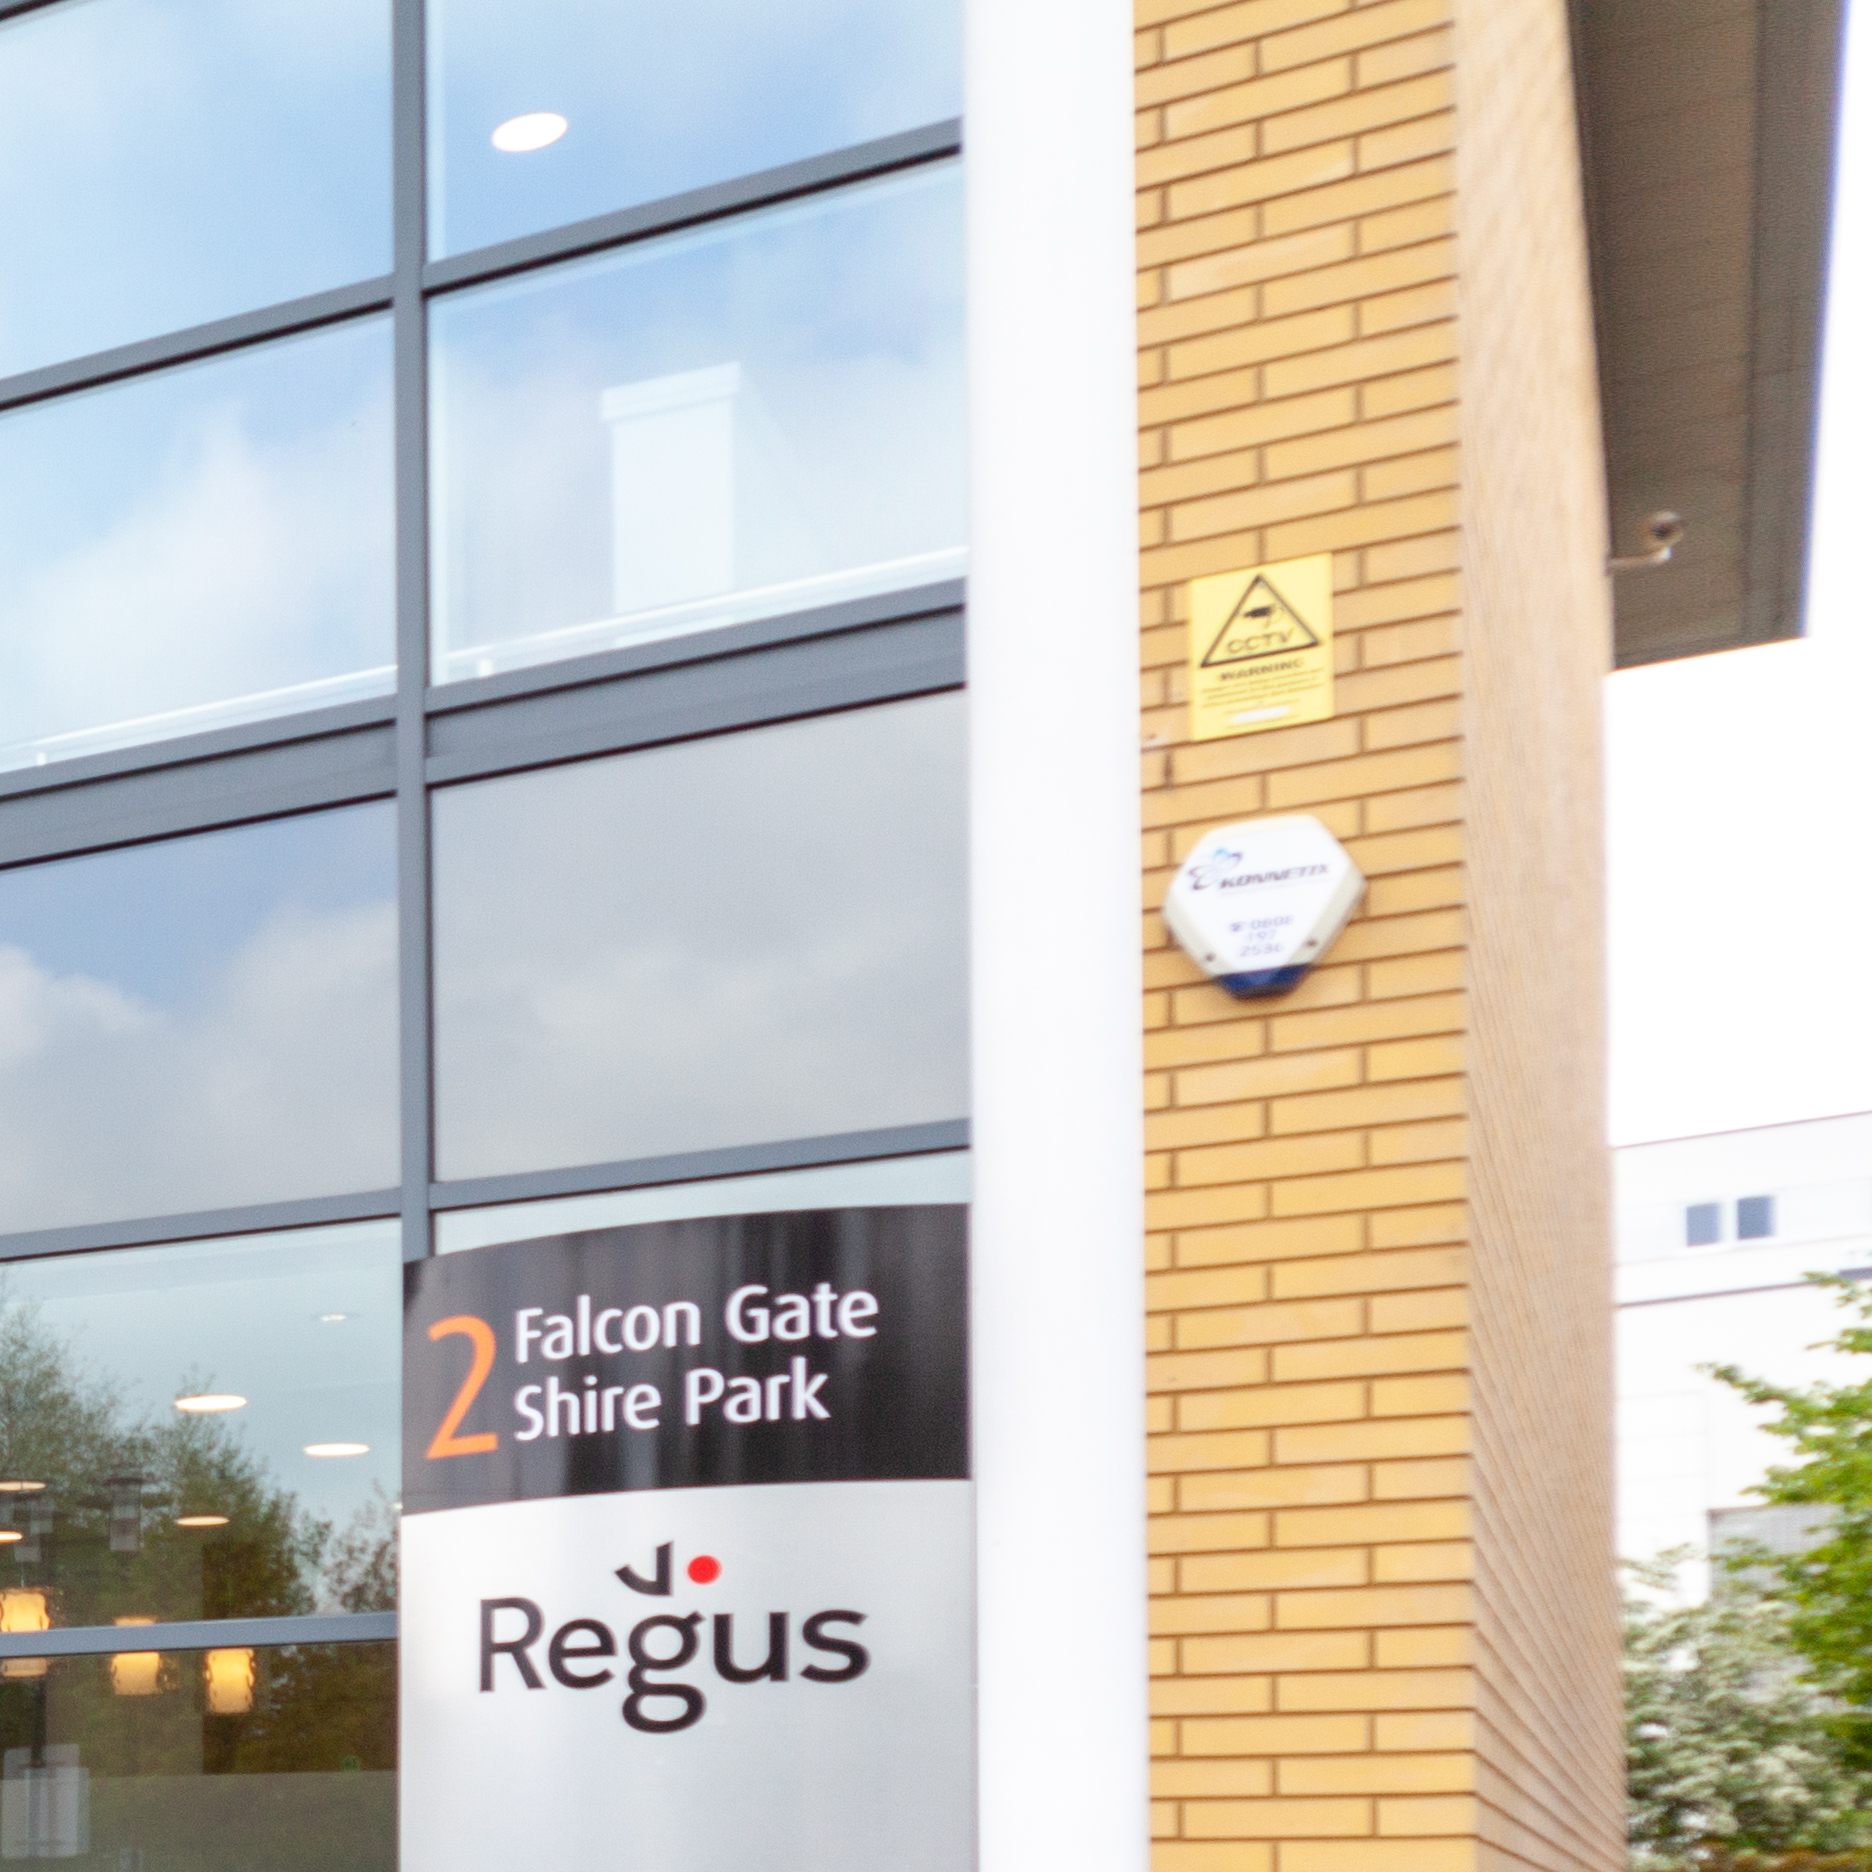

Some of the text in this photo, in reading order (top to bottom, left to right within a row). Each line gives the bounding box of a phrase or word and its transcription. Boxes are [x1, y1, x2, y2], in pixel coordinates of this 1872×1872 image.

[1219, 658, 1304, 681] WARNING
[1227, 627, 1294, 654] CCTV
[514, 1283, 880, 1364] Falcon Gate
[425, 1314, 500, 1461] 2
[513, 1356, 832, 1441] Shire Park
[478, 1595, 870, 1734] Regus
